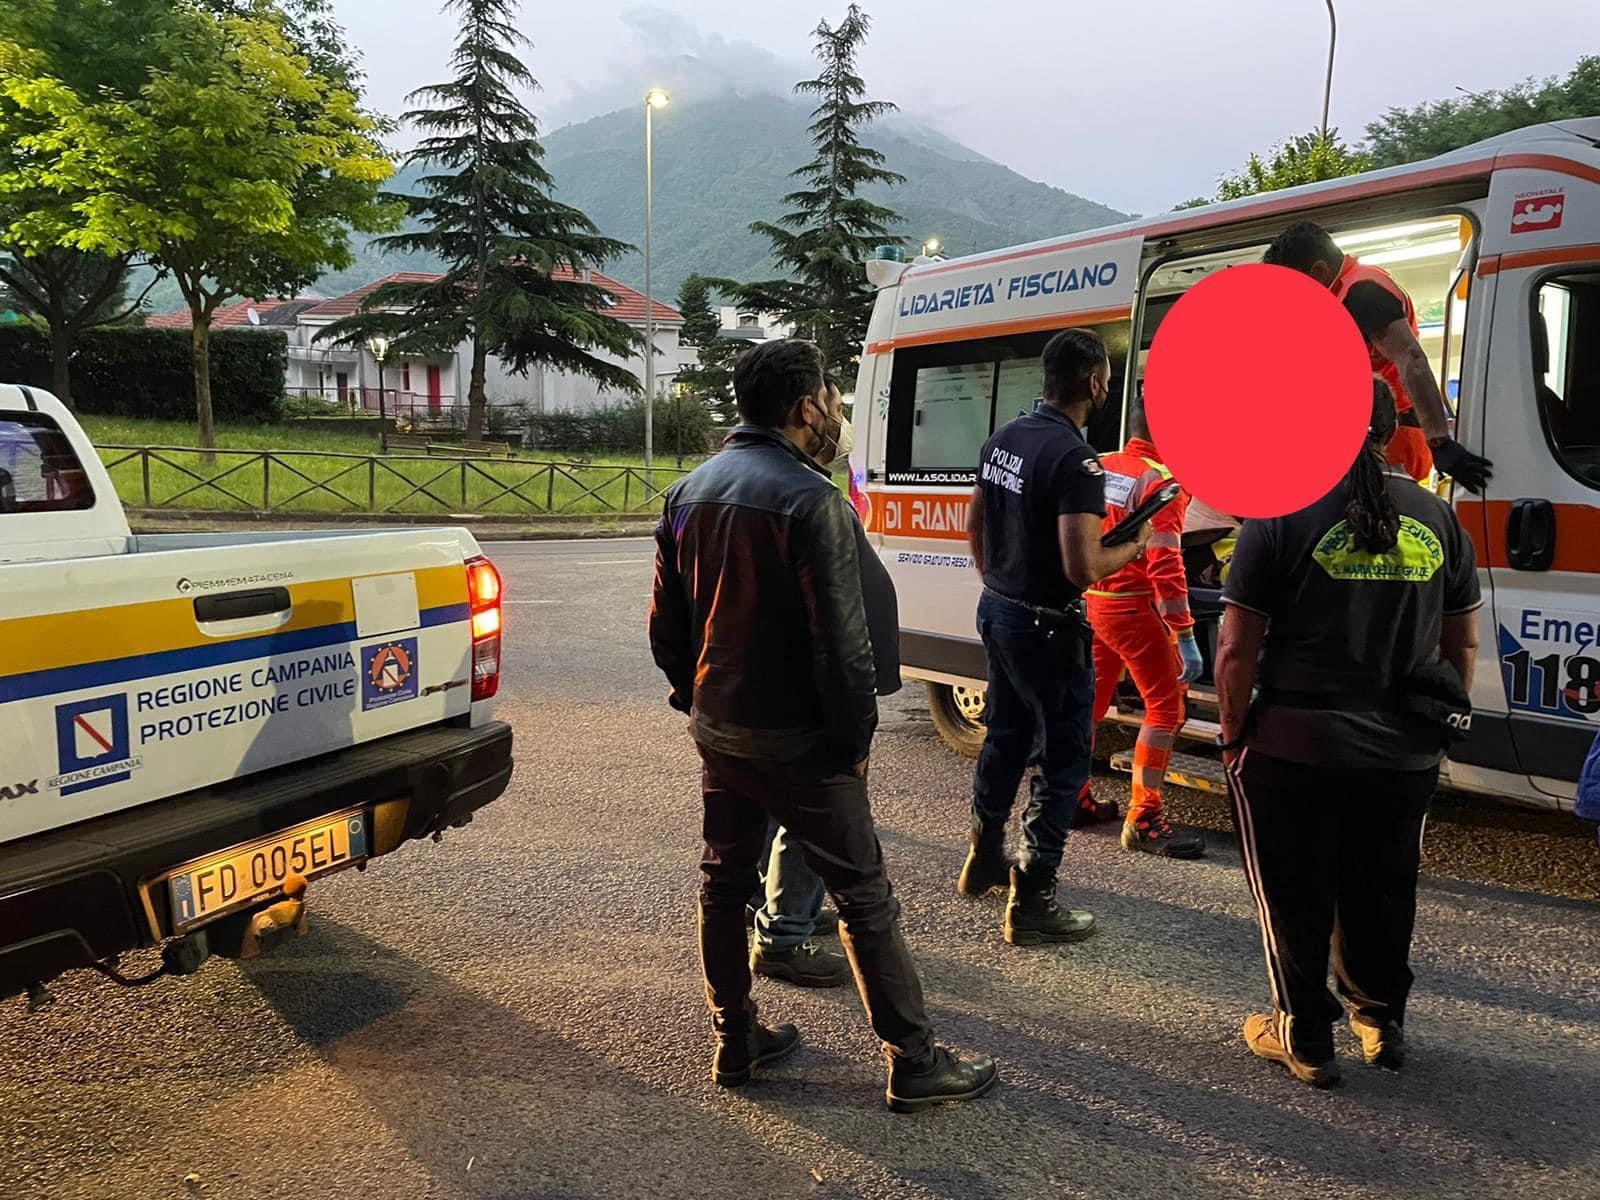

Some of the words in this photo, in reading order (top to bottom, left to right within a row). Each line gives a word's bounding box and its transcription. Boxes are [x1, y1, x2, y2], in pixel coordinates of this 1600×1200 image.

[1514, 187, 1565, 199] NEONATALE
[1007, 262, 1118, 300] FISCIANO
[885, 500, 902, 529] DI
[137, 673, 243, 712] REGIONE
[251, 650, 356, 688] CAMPANIA
[1503, 650, 1600, 714] 118
[140, 693, 290, 744] PROTEZIONE
[297, 678, 355, 707] CIVILE
[48, 769, 91, 788] REGIONE
[92, 758, 141, 777] CAMPANIA
[197, 863, 237, 912] FD
[251, 829, 346, 889] 005EL
